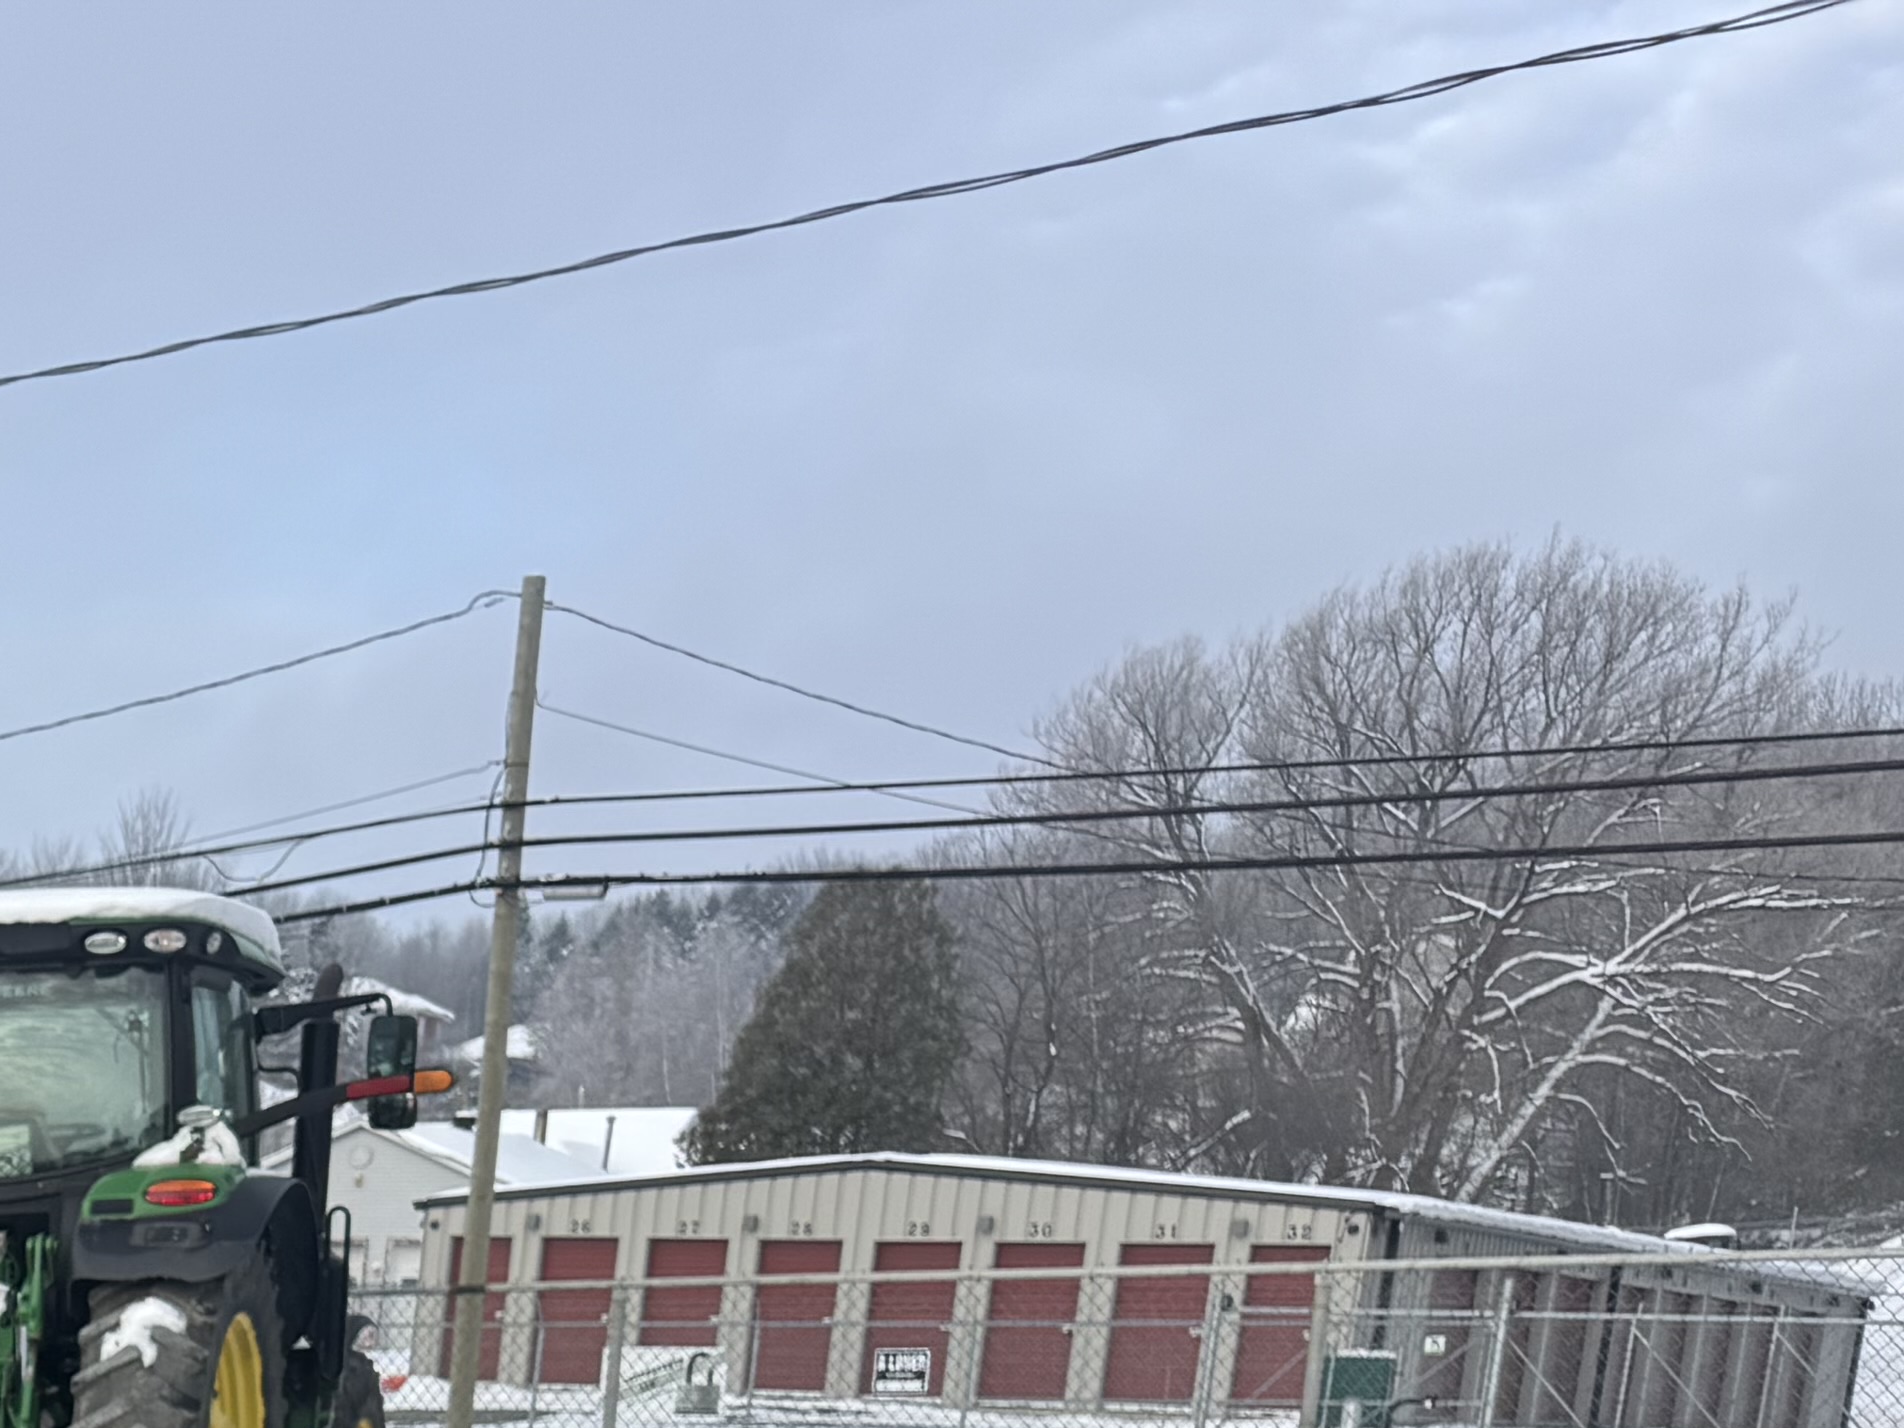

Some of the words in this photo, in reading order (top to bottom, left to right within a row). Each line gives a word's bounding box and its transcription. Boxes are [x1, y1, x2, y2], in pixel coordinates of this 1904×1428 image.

[908, 1222, 930, 1237] 29
[1028, 1222, 1052, 1238] 30
[1287, 1223, 1312, 1240] 32
